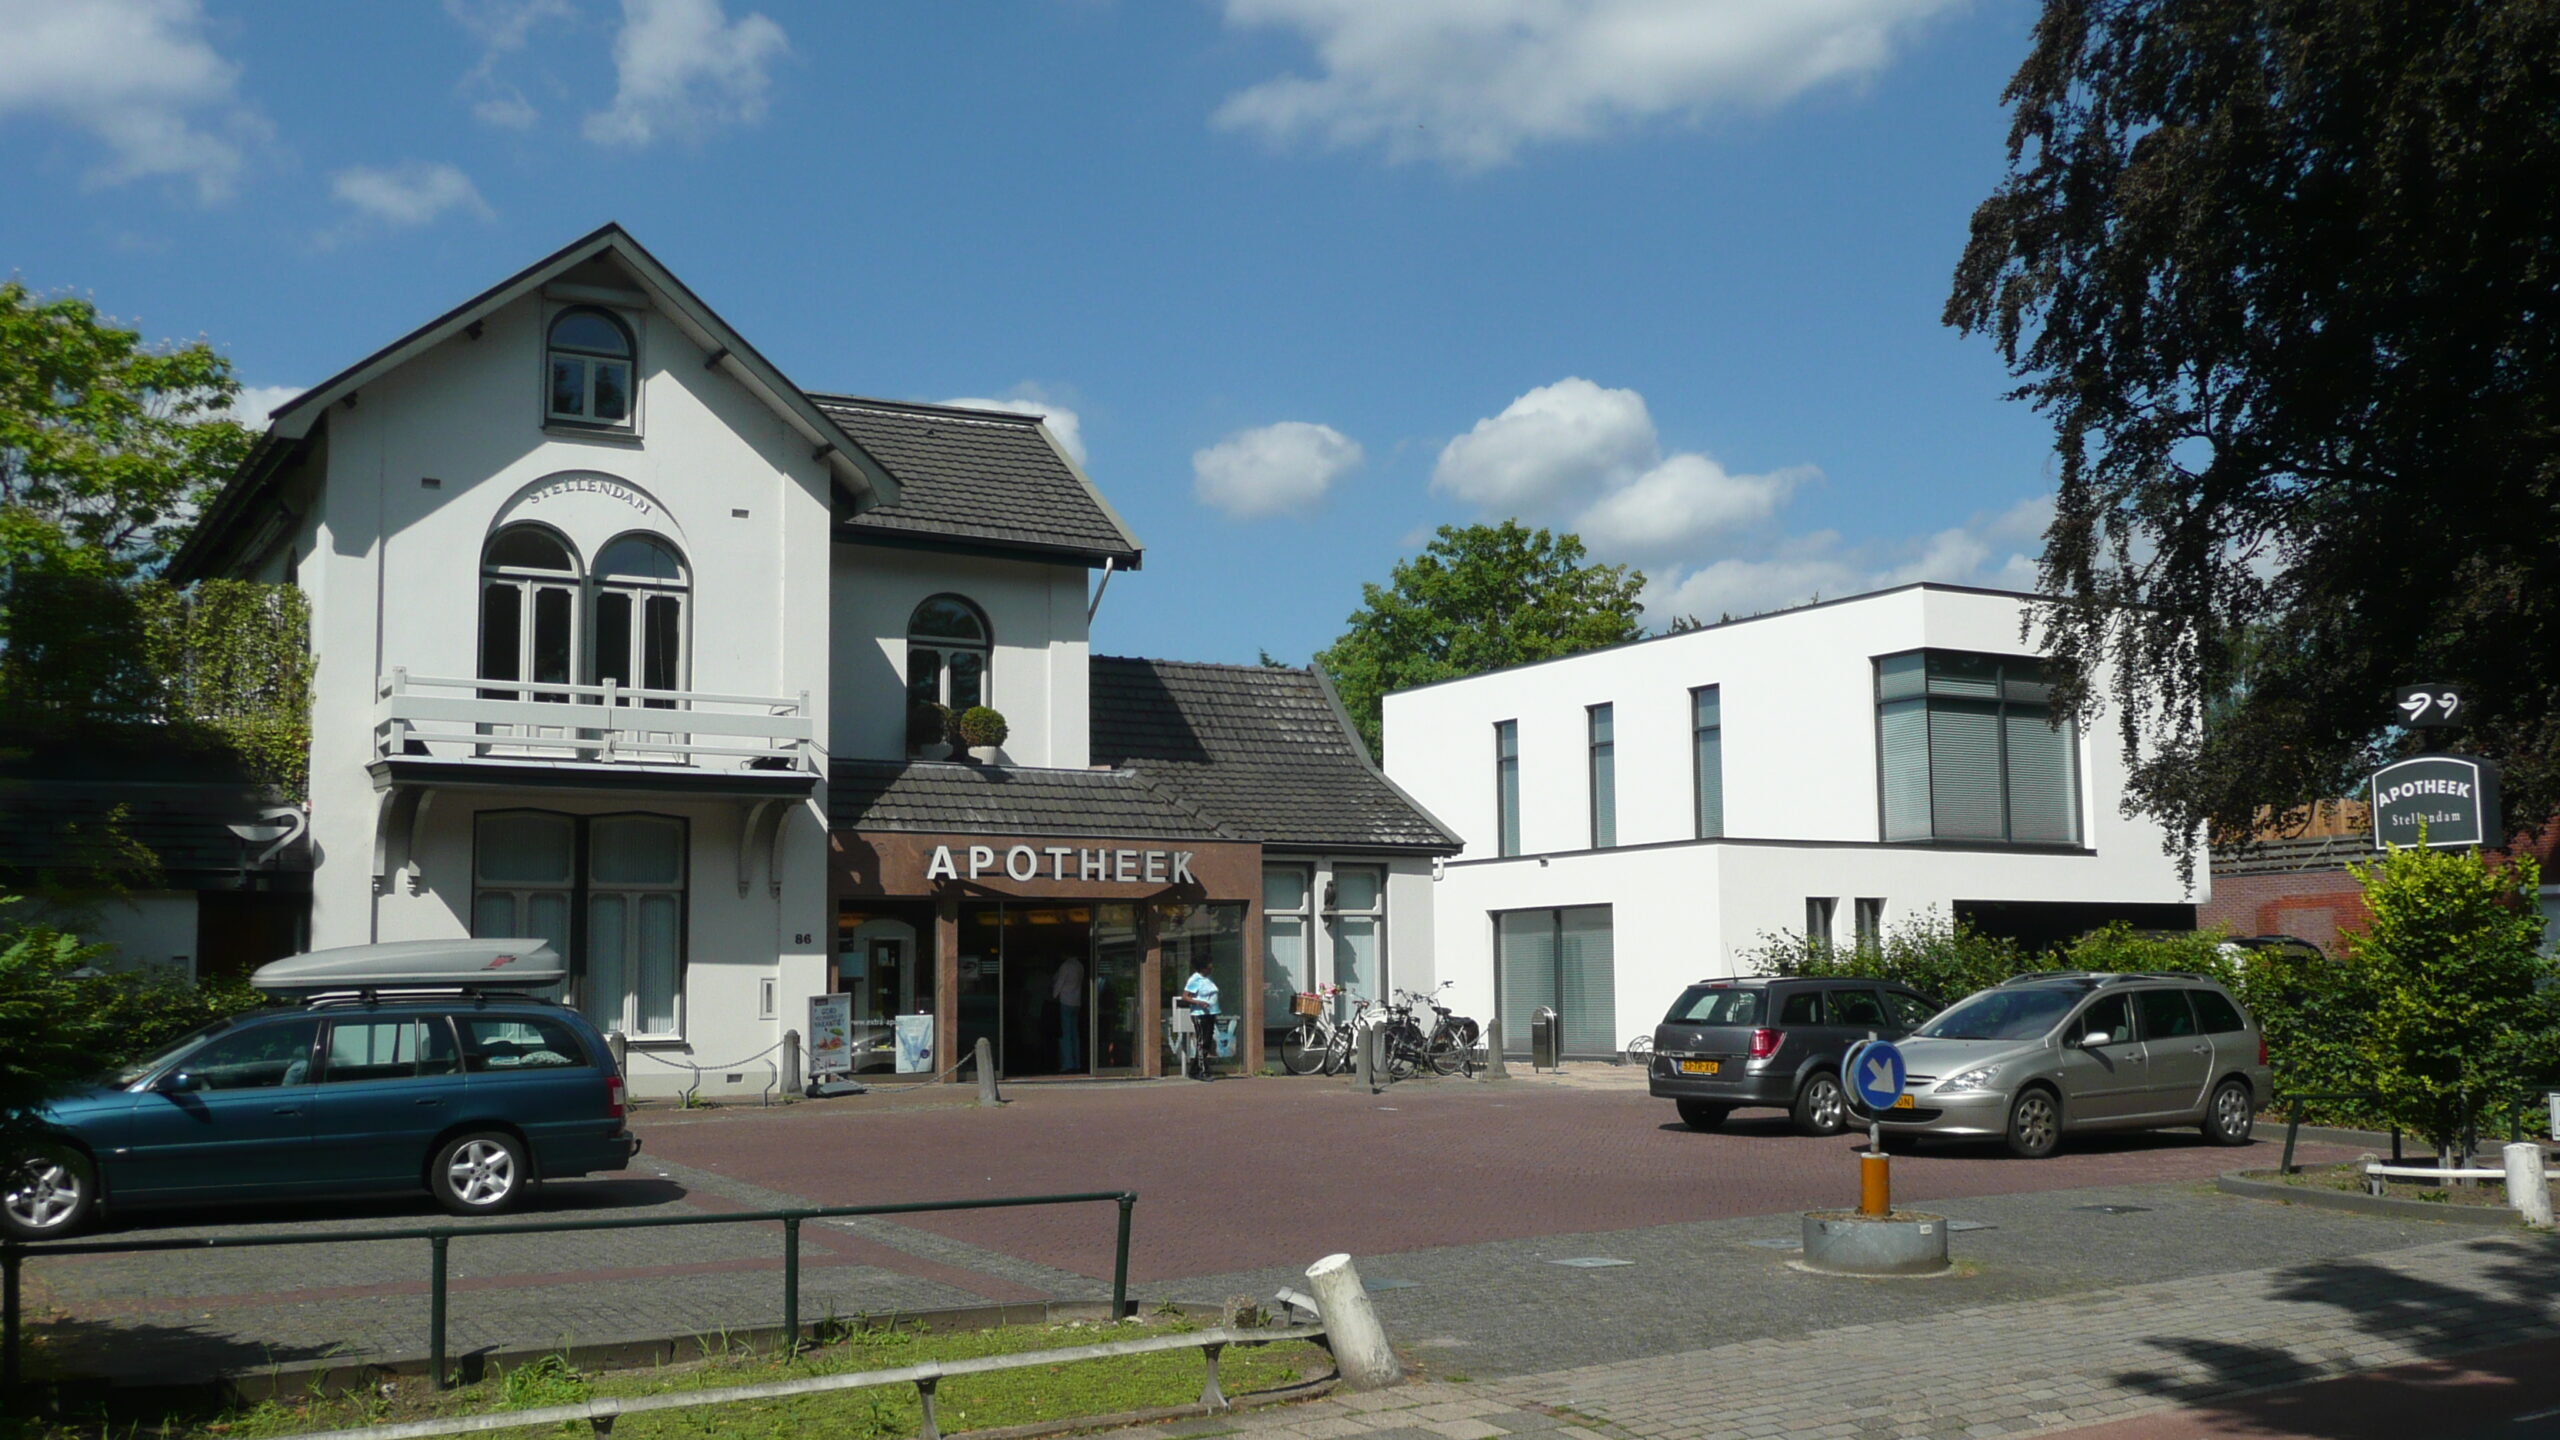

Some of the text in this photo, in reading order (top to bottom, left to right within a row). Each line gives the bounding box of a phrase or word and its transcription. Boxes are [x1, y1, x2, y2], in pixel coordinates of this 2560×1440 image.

[527, 478, 652, 516] STELLENDAM
[2378, 779, 2471, 807] APOTHEEK
[926, 845, 1195, 884] APOTHEEK
[795, 933, 812, 944] 86
